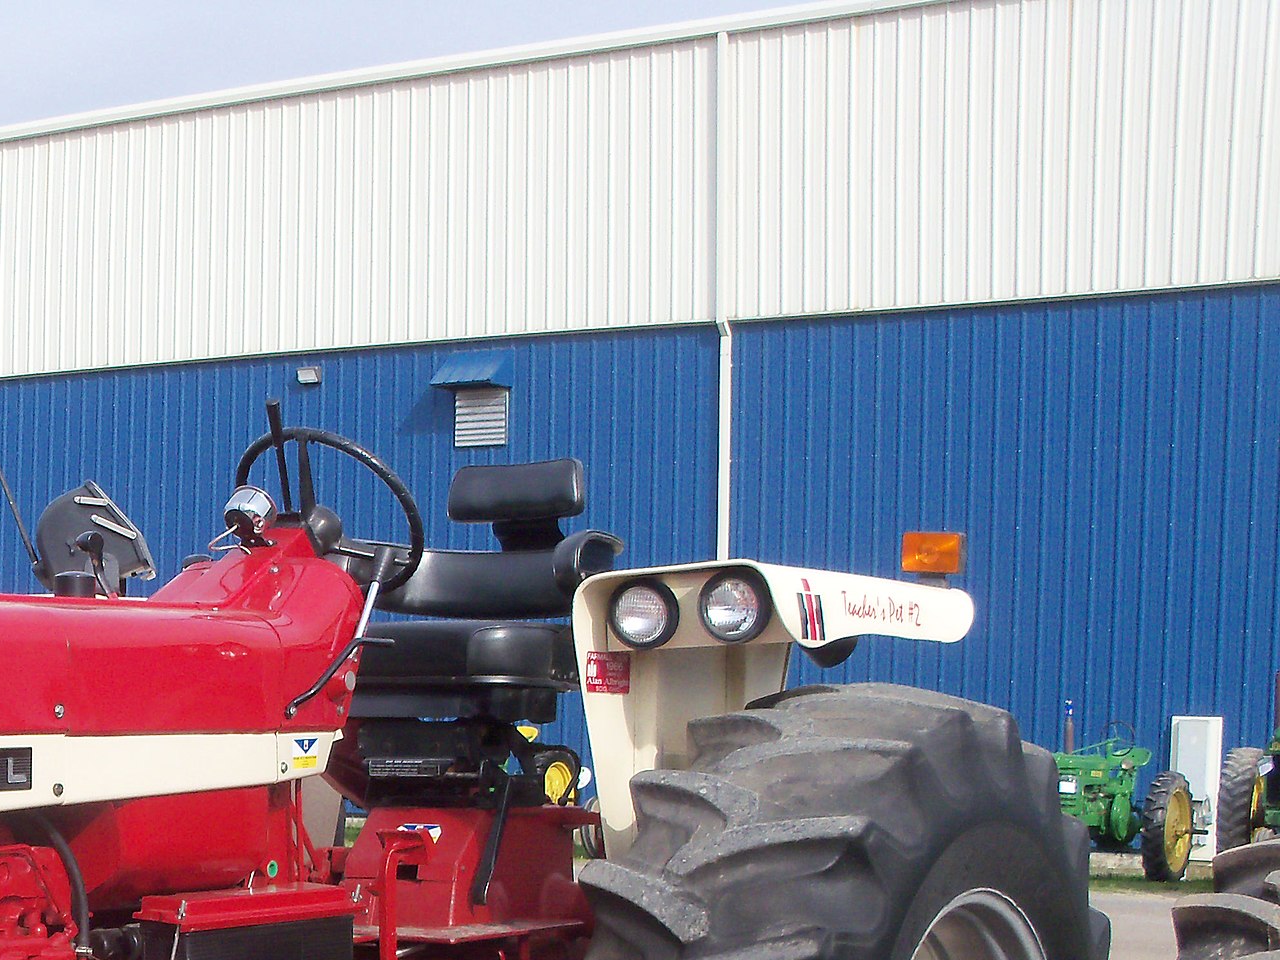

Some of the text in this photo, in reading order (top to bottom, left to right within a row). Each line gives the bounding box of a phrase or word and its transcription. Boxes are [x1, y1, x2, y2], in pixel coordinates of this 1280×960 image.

[841, 590, 921, 627] Teacher's Pet #2
